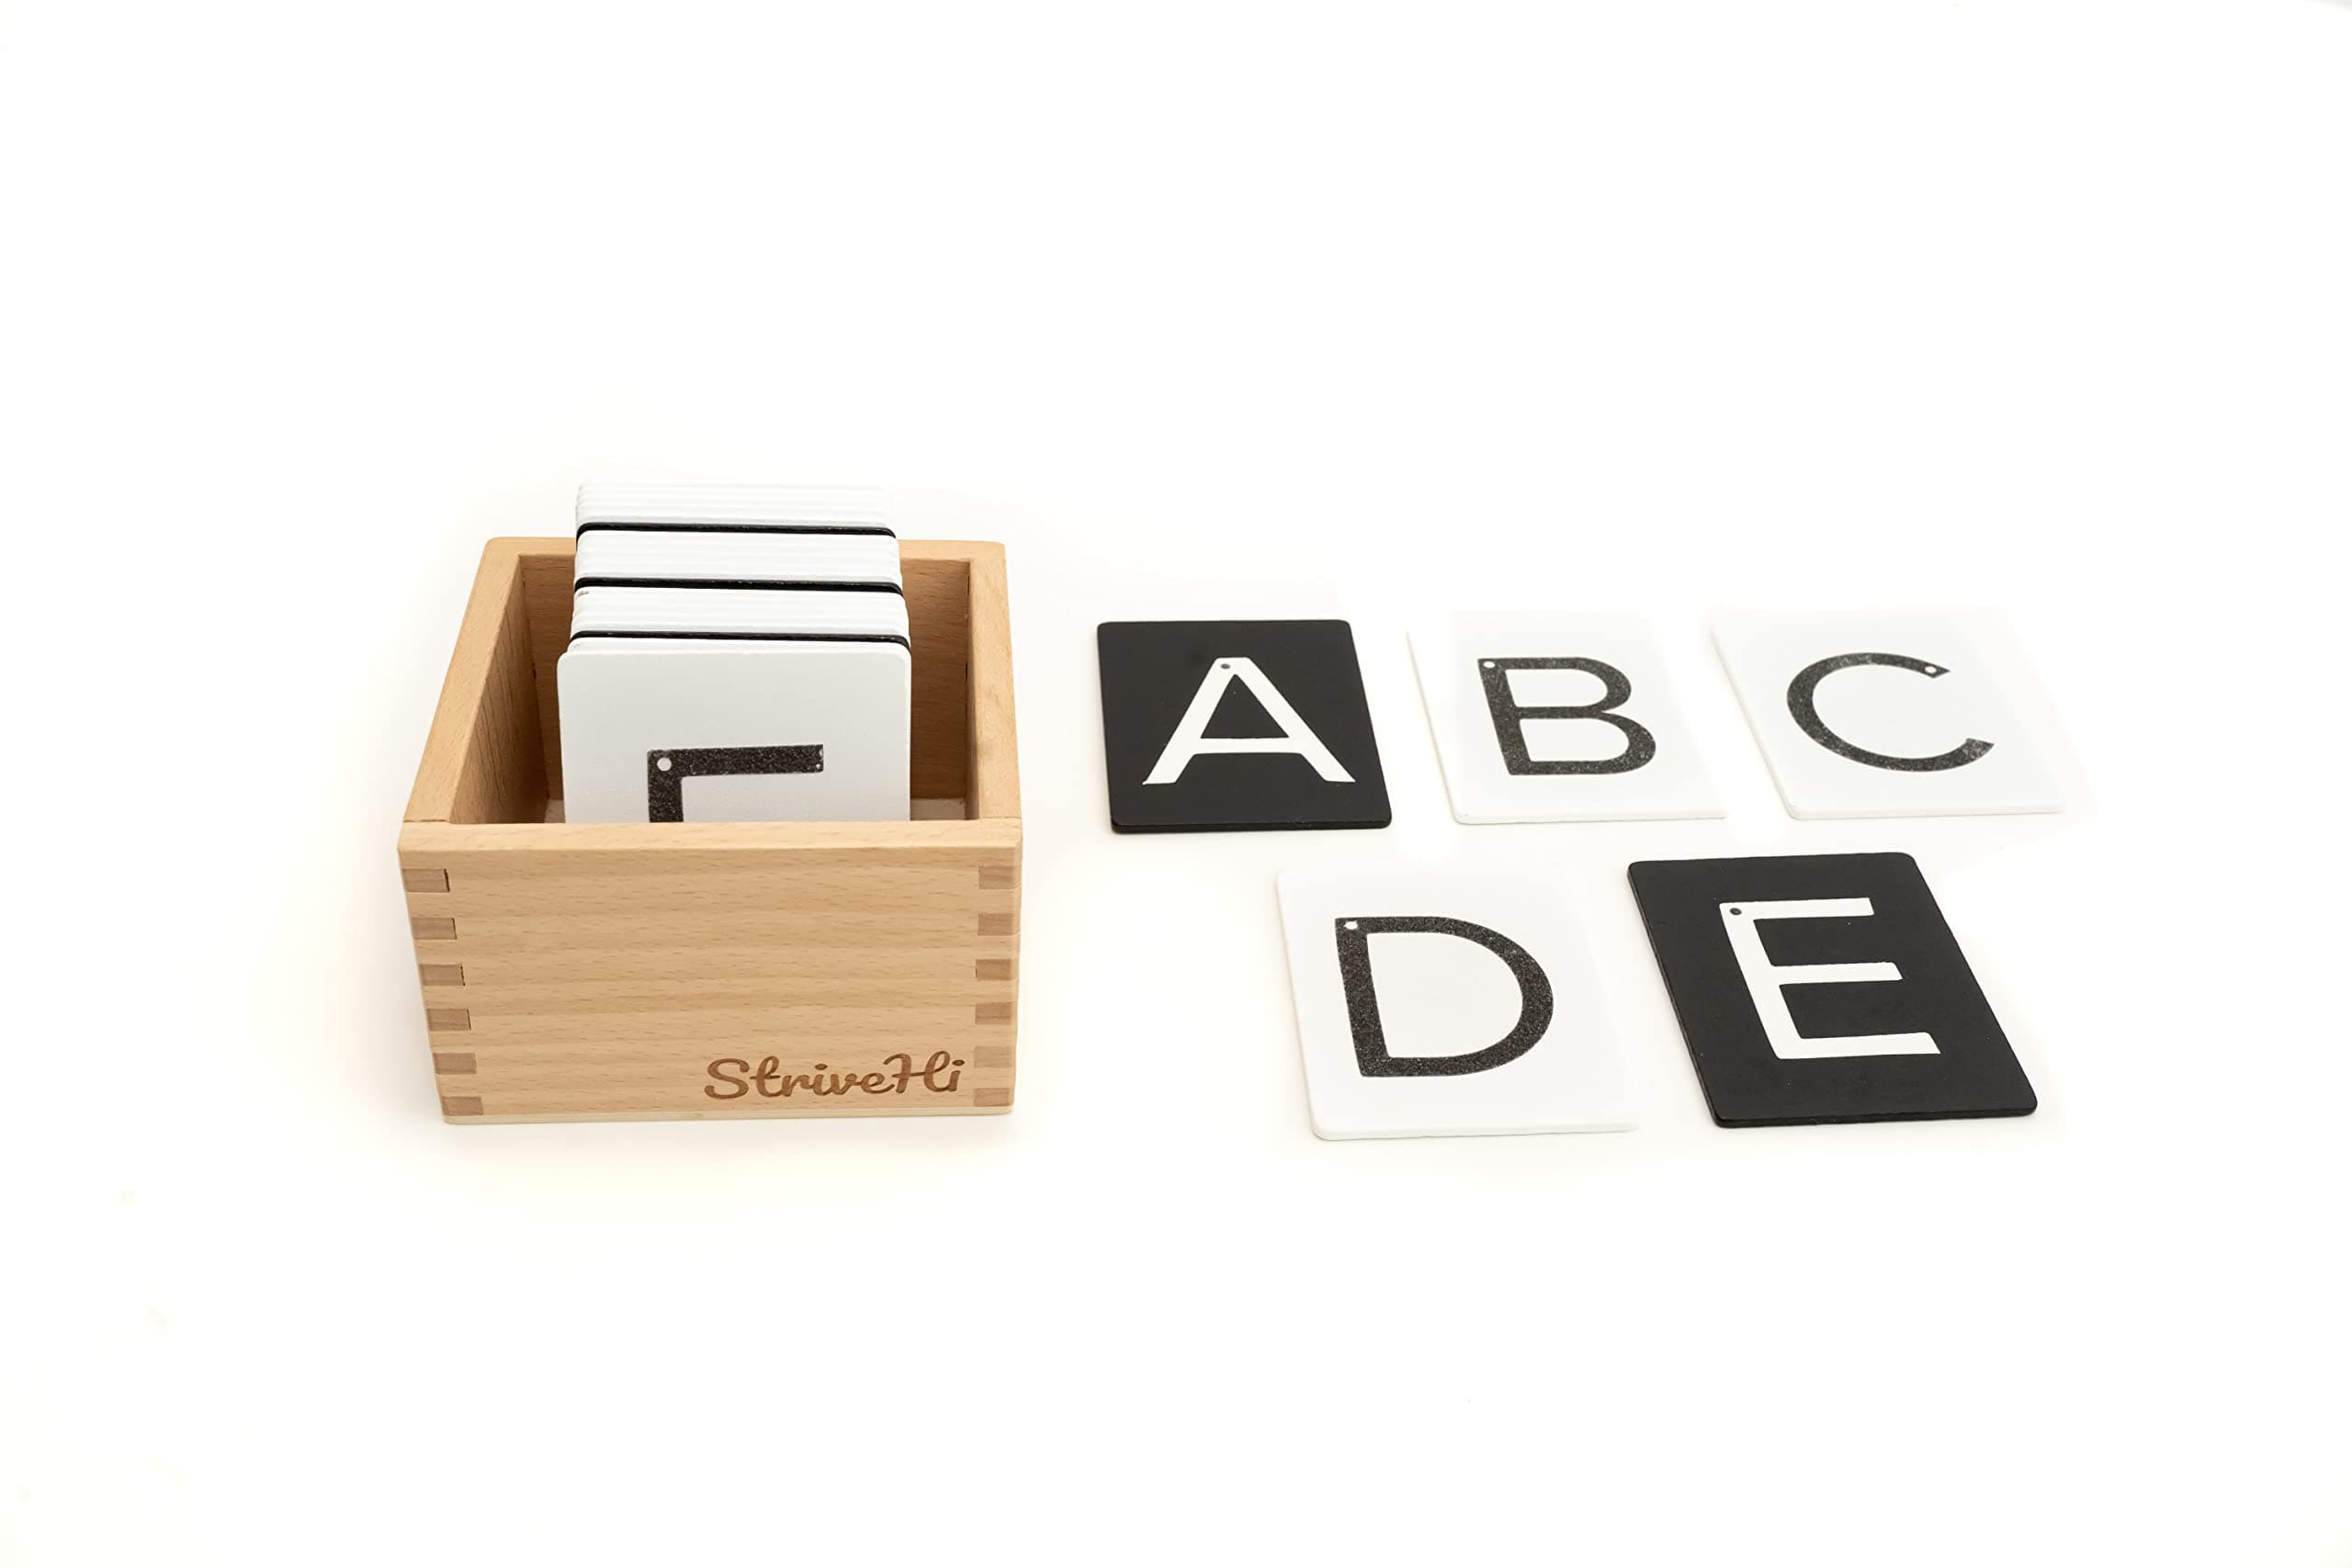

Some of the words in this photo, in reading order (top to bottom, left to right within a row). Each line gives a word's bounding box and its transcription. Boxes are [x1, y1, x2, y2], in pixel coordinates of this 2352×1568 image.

[1143, 658, 1355, 785] A
[1478, 657, 1657, 776] B
[1786, 653, 1995, 773] C
[1334, 916, 1554, 1078] D
[1719, 897, 1940, 1060] E
[704, 1051, 966, 1100] StriveHi
